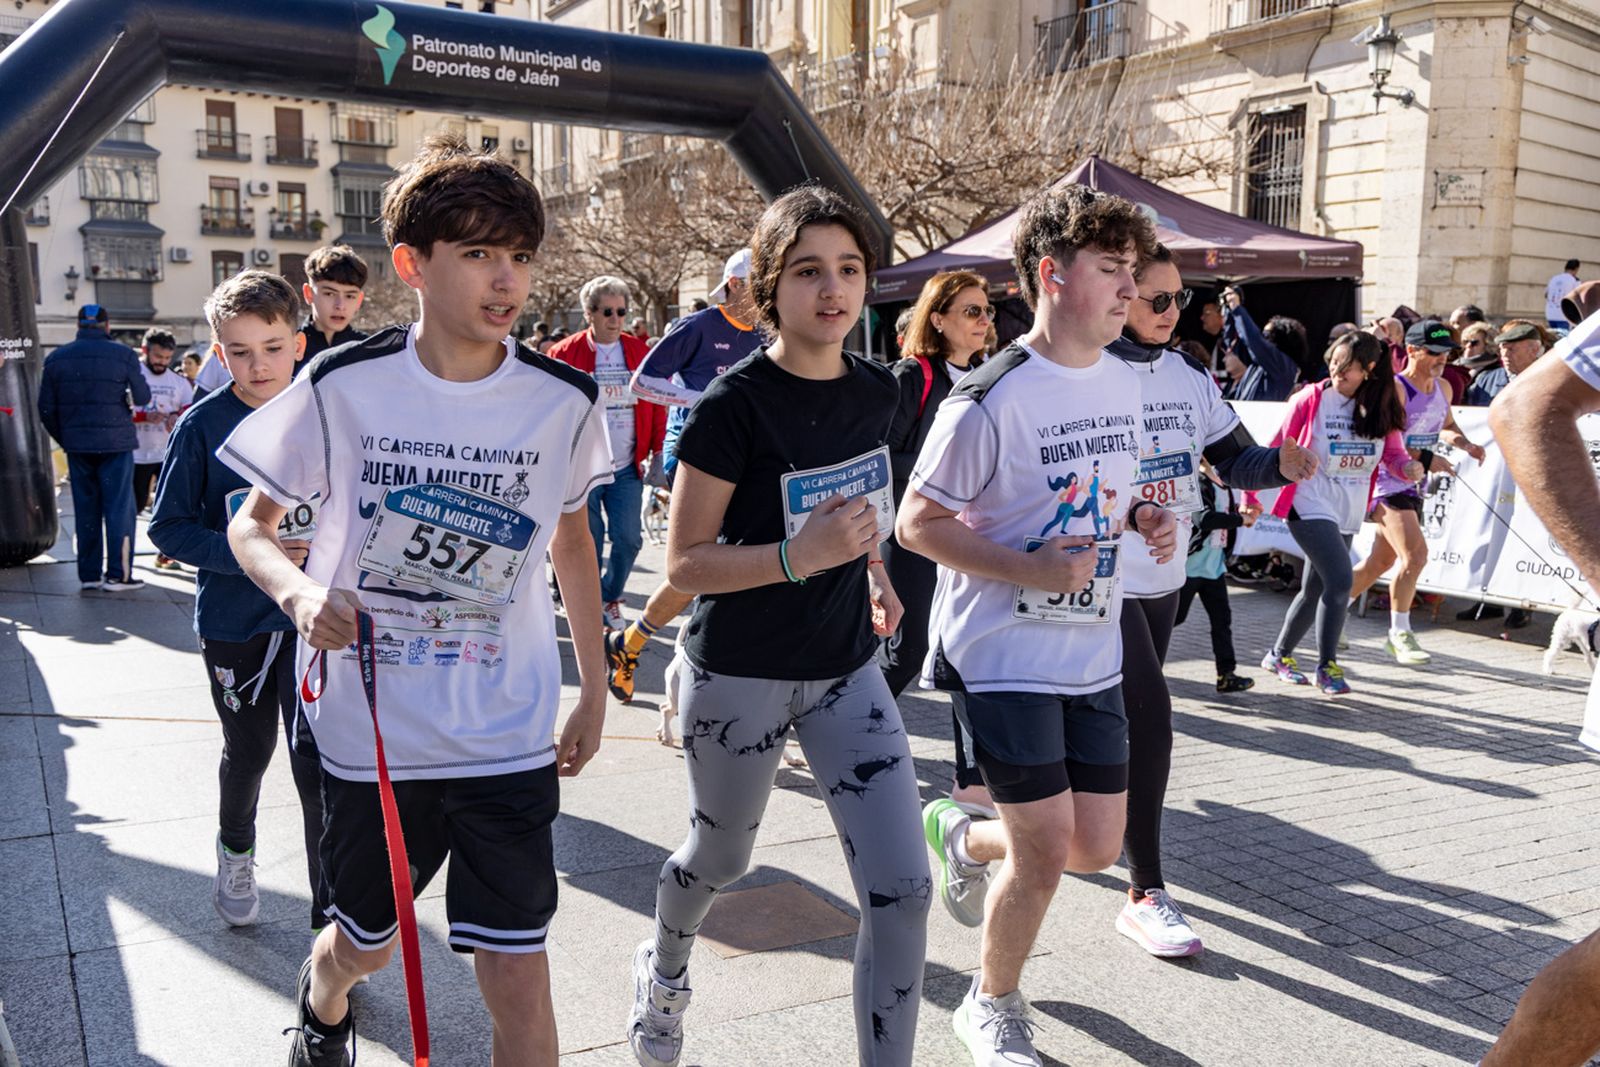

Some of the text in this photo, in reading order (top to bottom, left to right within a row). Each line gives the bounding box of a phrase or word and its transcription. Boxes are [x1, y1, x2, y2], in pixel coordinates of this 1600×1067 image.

[412, 34, 602, 73] Patronato Municipal de
[412, 55, 560, 87] Deportes de Jaén
[1037, 427, 1050, 439] VI
[1051, 418, 1097, 437] CARRERA
[1144, 416, 1181, 433] MUERTE
[360, 435, 540, 466] VI CARRERA CAMINATA
[1040, 433, 1128, 465] BUENA MUERTE
[1340, 456, 1365, 468] 810
[361, 459, 418, 486] BUENA
[800, 459, 879, 490] VI CARRERA CAMINATA
[420, 485, 468, 508] CARRERA
[469, 500, 520, 525] CAMINATA
[1142, 479, 1176, 504] 981
[278, 503, 313, 532] 40
[401, 494, 493, 536] BUENA MUERTE
[402, 523, 492, 575] 557
[404, 560, 432, 574] MARCOS
[1515, 559, 1575, 580] CIUDAD
[371, 606, 404, 617] beneficio
